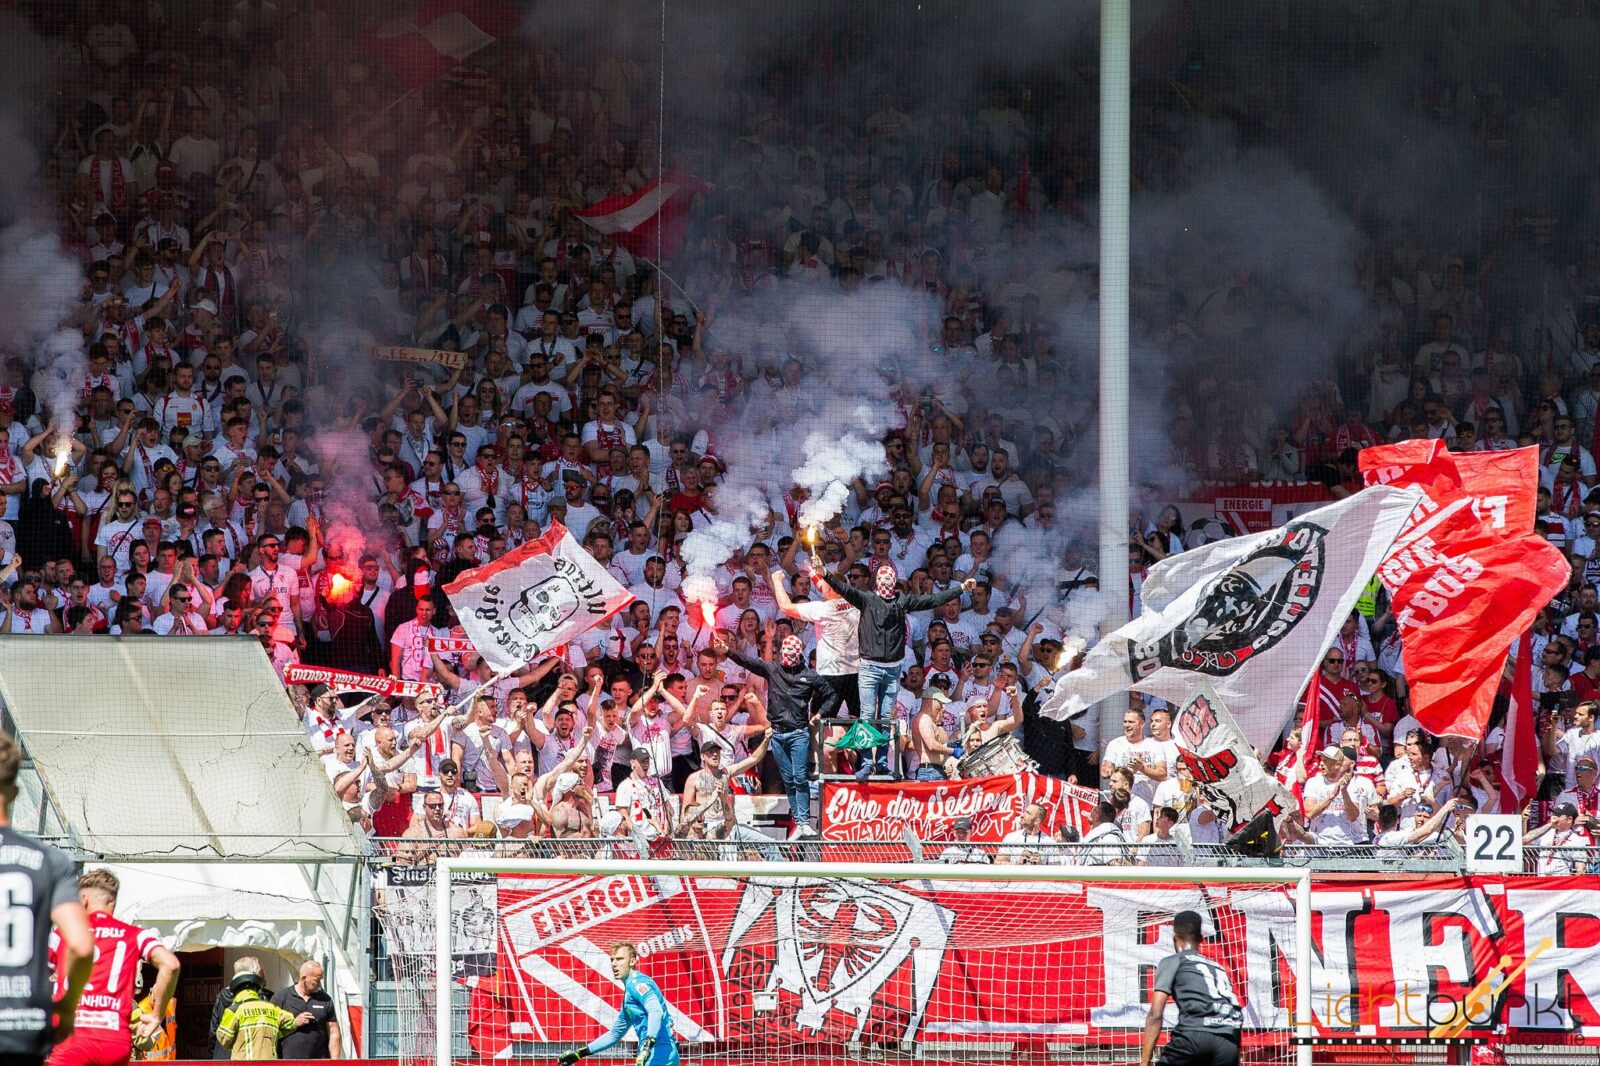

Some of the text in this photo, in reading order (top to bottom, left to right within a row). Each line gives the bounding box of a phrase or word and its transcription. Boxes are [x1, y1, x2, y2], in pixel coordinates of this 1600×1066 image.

[1223, 499, 1264, 510] ENERGIE
[886, 791, 922, 818] der
[1473, 824, 1516, 861] 22
[636, 923, 694, 958] OTTBUS
